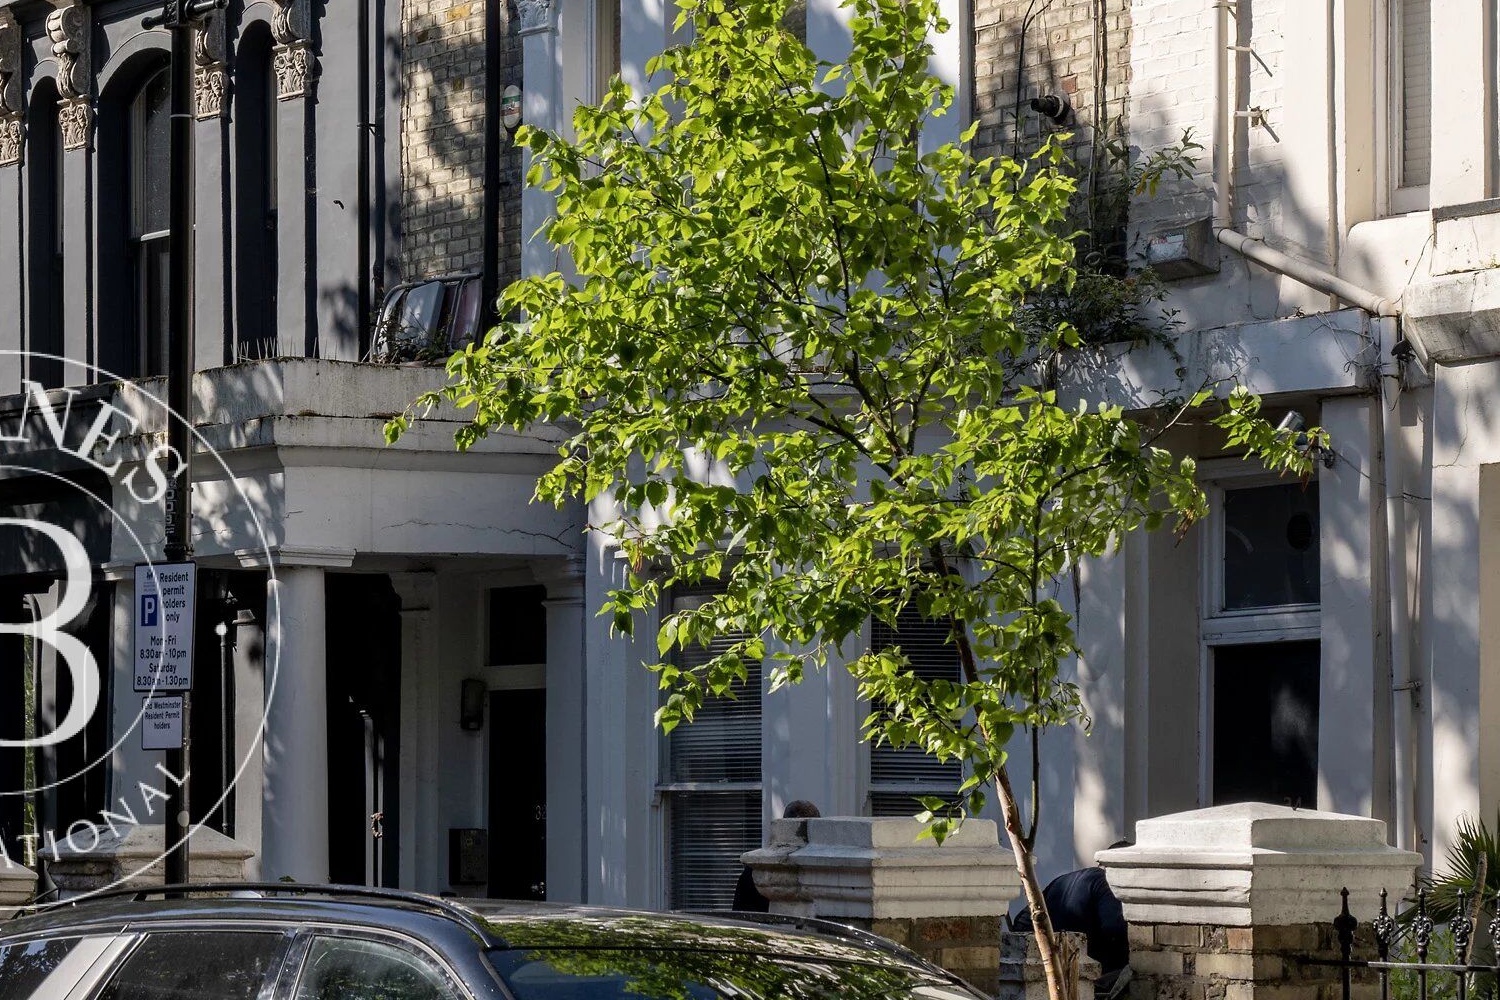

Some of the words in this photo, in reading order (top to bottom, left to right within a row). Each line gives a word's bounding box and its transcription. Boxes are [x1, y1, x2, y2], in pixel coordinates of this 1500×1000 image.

[159, 571, 189, 583] Resident
[162, 585, 185, 597] permit
[165, 611, 181, 623] only
[148, 662, 177, 674] Saturday
